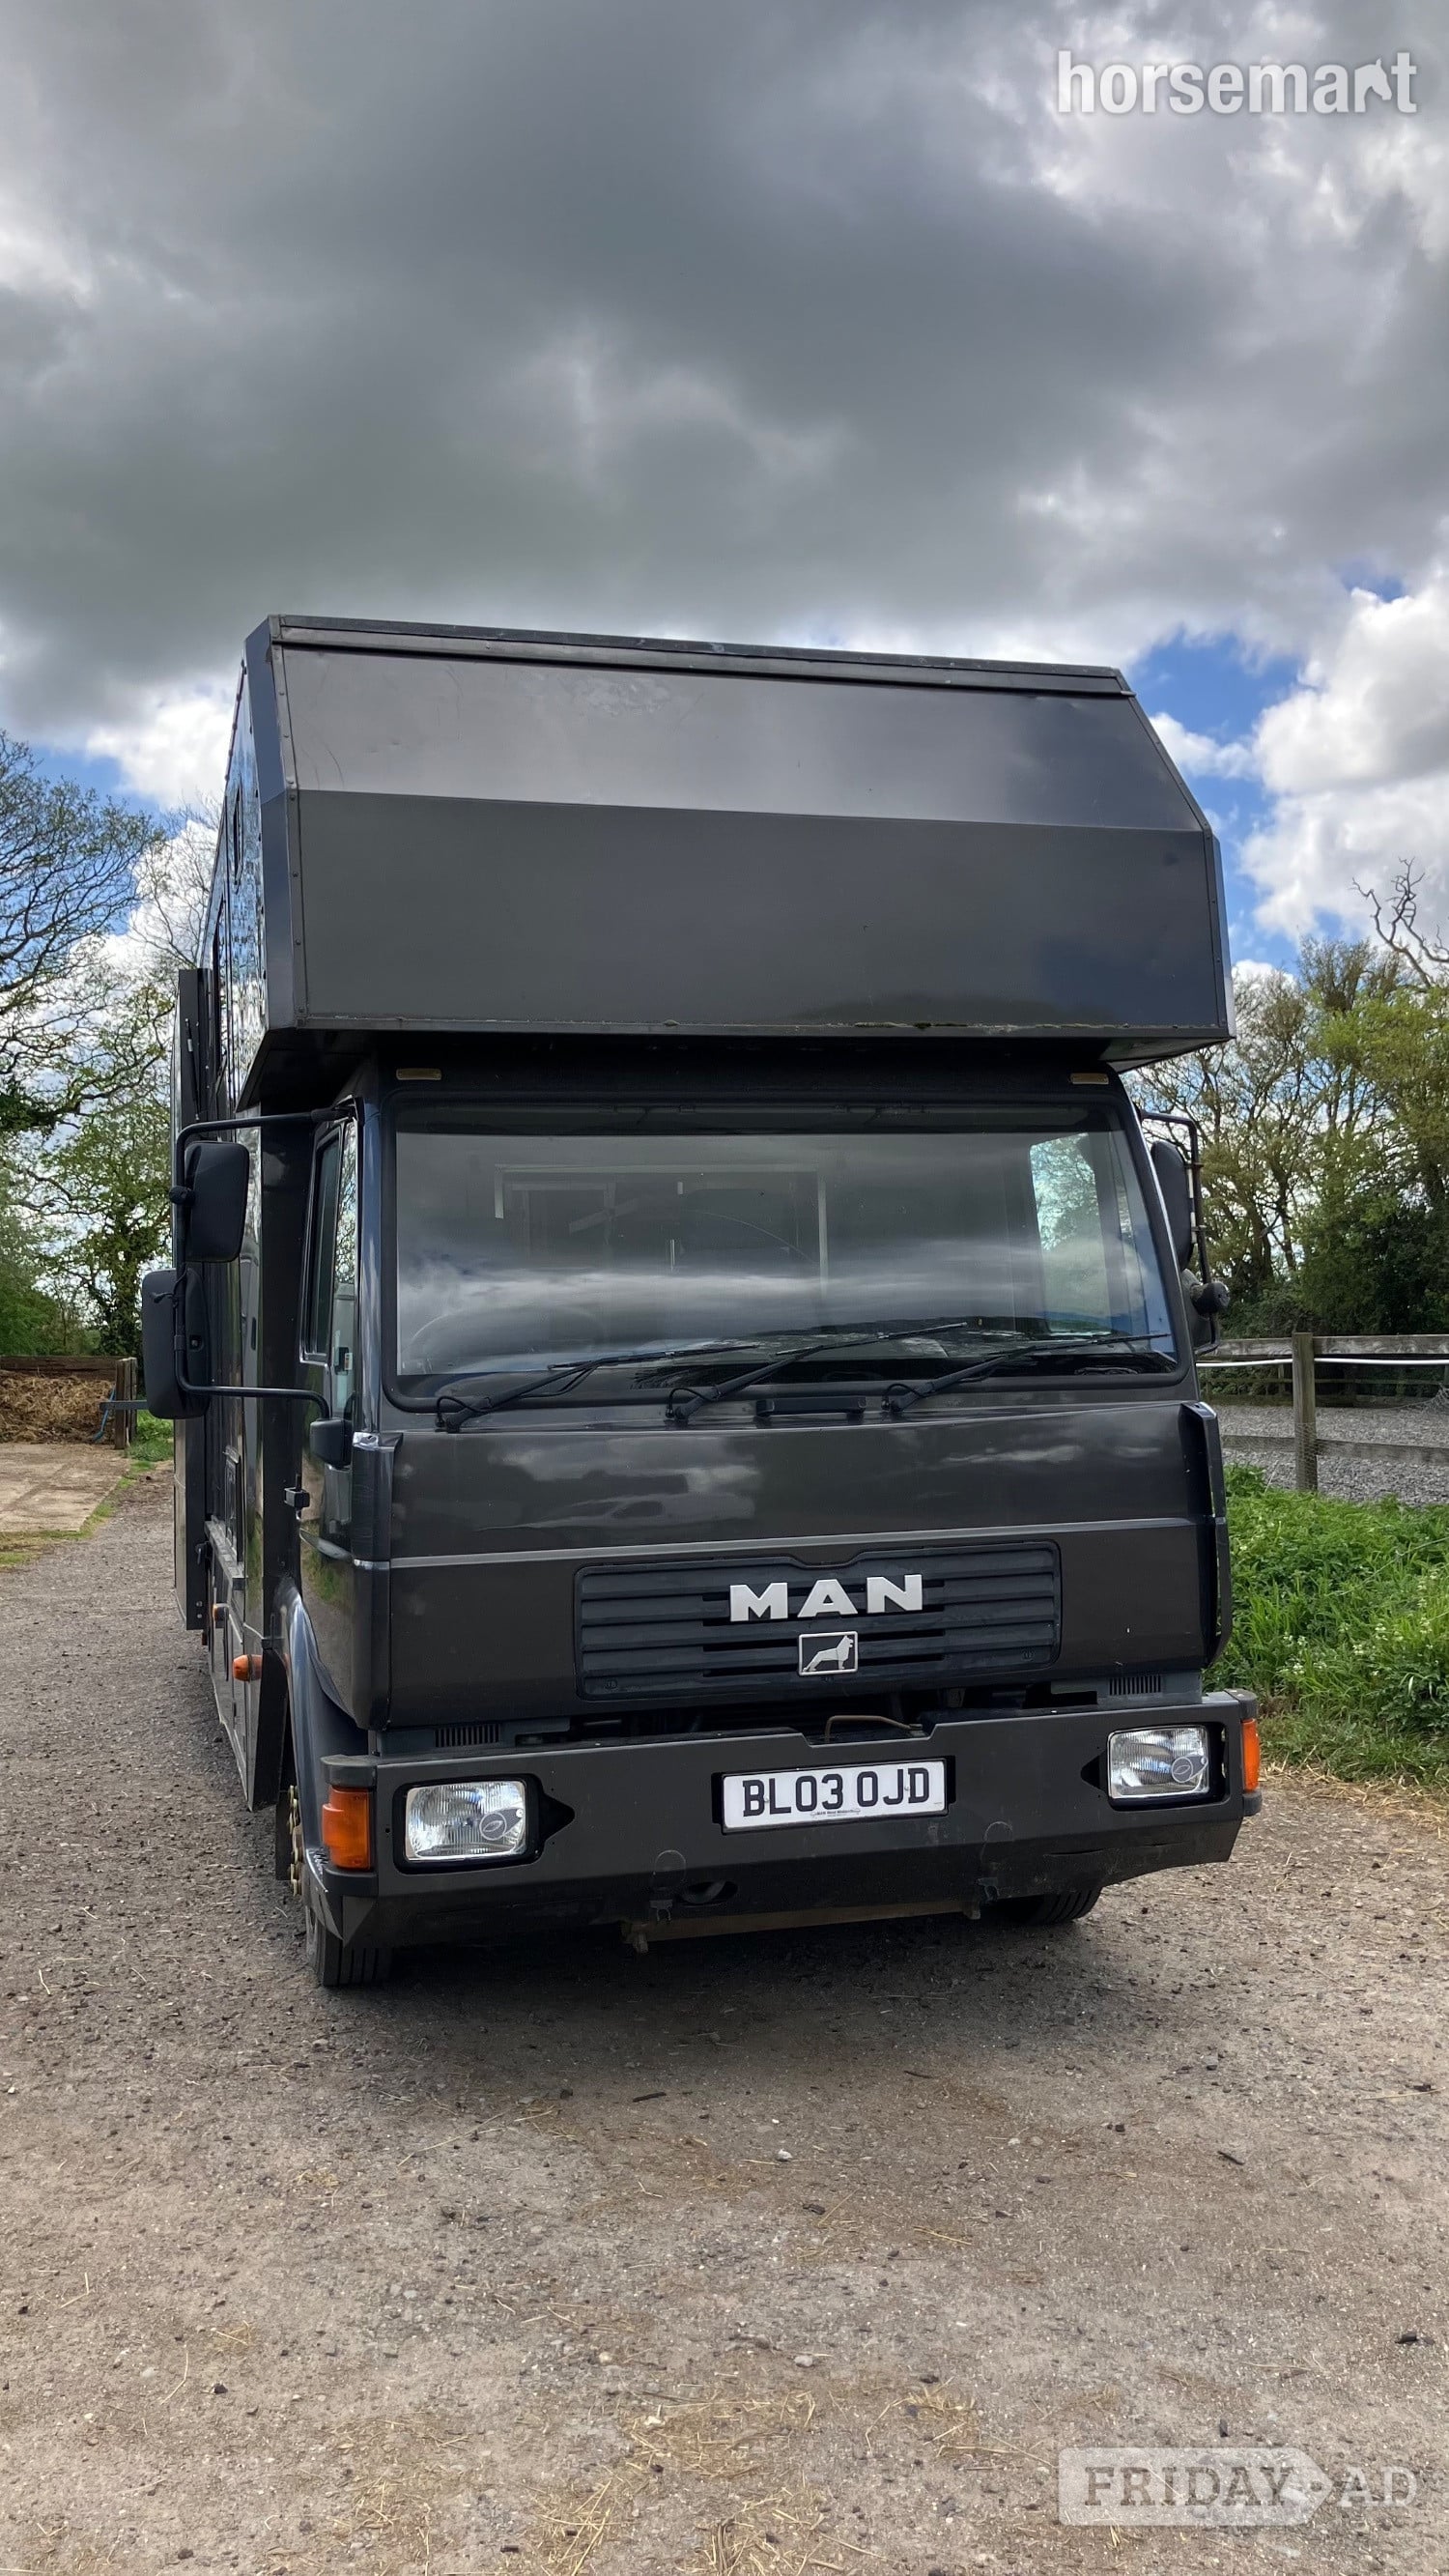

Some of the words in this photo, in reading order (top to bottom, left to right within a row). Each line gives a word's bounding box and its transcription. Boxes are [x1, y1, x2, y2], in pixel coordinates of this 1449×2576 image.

[729, 1574, 923, 1622] MAN
[742, 1773, 843, 1818] BL03
[856, 1767, 929, 1808] OJD
